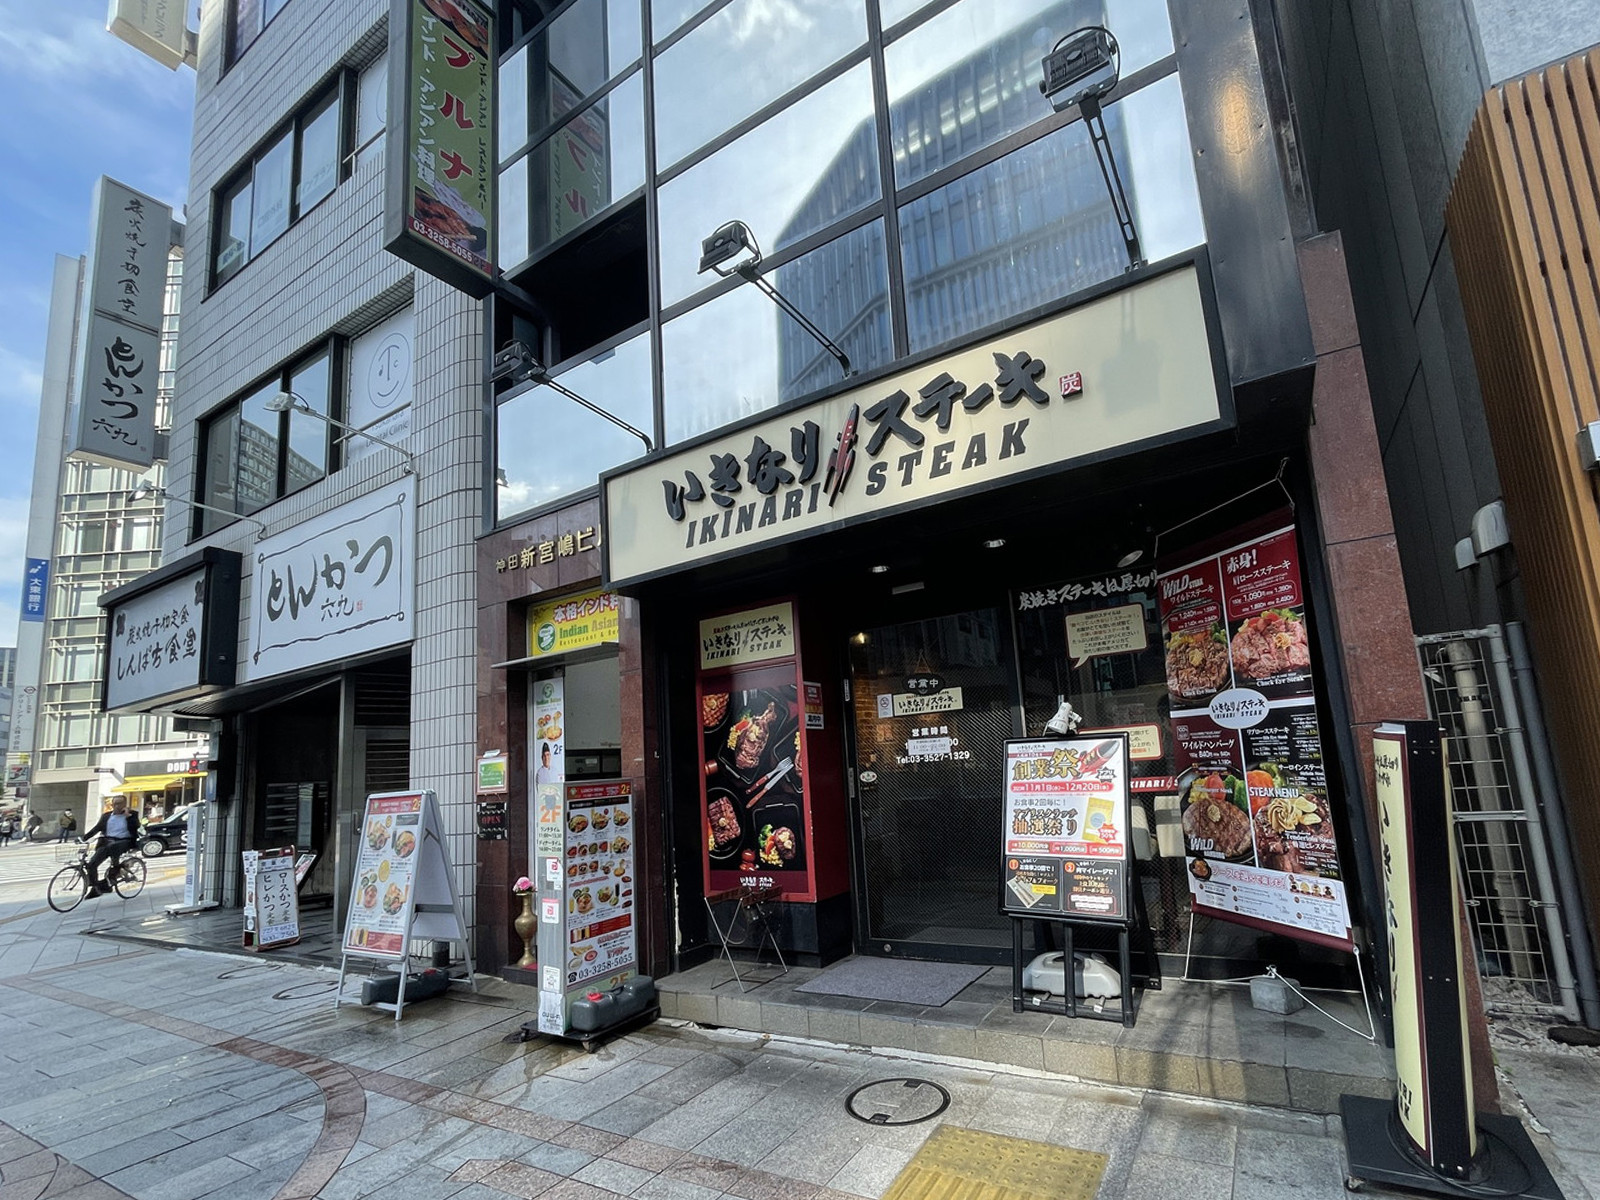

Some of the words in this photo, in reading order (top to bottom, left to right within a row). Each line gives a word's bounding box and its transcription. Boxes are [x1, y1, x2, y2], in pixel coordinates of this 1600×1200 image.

[418, 15, 437, 187] インド・アジアン料理
[438, 34, 475, 180] プルナ
[413, 219, 473, 262] 03-3258-5055
[101, 336, 144, 419] とんかつ
[92, 417, 138, 446] 六九
[661, 420, 821, 522] いきなり
[862, 351, 1050, 457] ステーキ
[685, 482, 821, 549] IKINARI
[864, 418, 1031, 497] STEAK
[266, 535, 393, 622] とんかつ
[27, 577, 43, 612] 大東銀行
[320, 594, 354, 622] 六九
[559, 624, 589, 639] Indian
[702, 630, 741, 652] いきなり
[750, 623, 787, 642] ステーキ
[749, 640, 783, 653] STEAK
[907, 678, 939, 689] 営業中
[1211, 701, 1237, 713] いきなり
[1240, 697, 1267, 710] ステーキ
[911, 725, 948, 737] 営業時間
[1182, 739, 1236, 750] ワイルドハンバーグ
[554, 743, 563, 756] 2F
[896, 751, 971, 764] Tel:03-3527-1329
[1012, 747, 1081, 781] 創業祭
[620, 784, 630, 795] 2F
[1248, 786, 1275, 798] STEAK
[1275, 787, 1299, 798] MENU
[540, 805, 562, 823] 2F
[1012, 818, 1079, 836] 抽選祭り
[578, 952, 633, 979] 03-3258-5055
